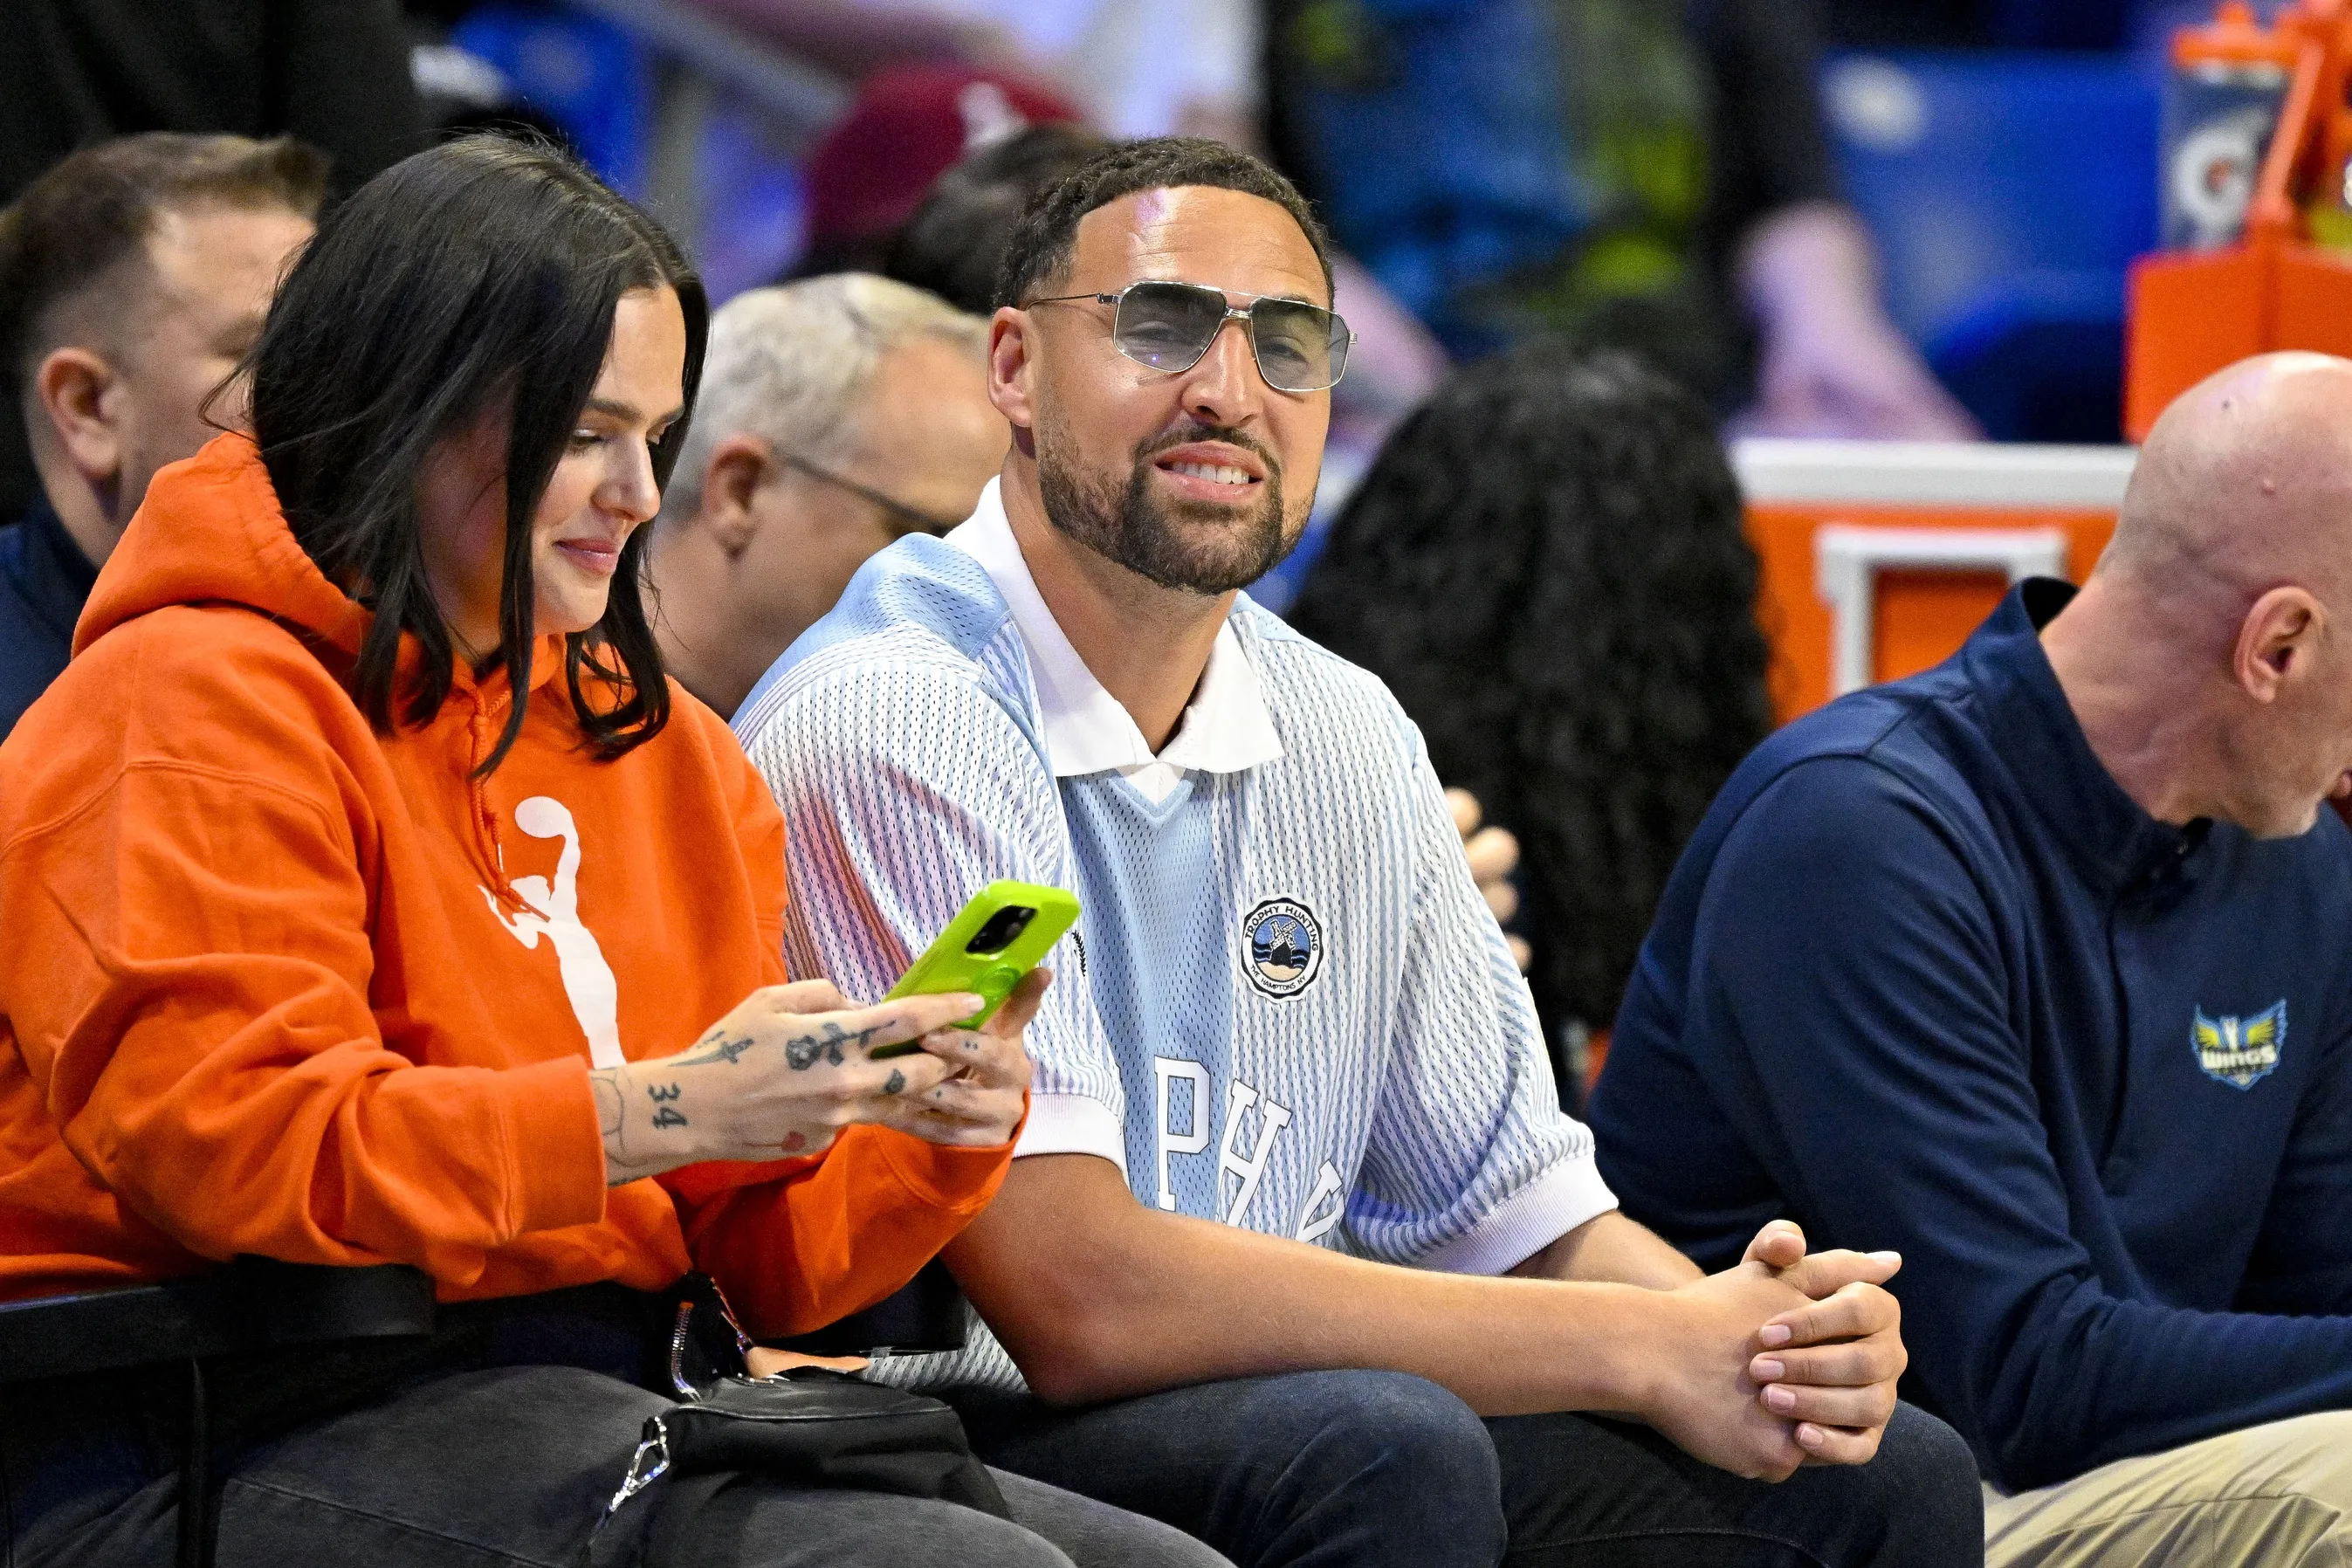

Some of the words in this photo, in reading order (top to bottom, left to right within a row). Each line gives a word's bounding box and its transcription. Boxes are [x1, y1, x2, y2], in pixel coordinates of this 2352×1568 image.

[1244, 905, 1280, 939] TROPHY
[1285, 905, 1319, 952] HUNTING
[1250, 964, 1261, 978] THE
[1261, 978, 1296, 991] HAMPTONS
[1297, 975, 1307, 986] NY
[648, 1083, 689, 1130] 34
